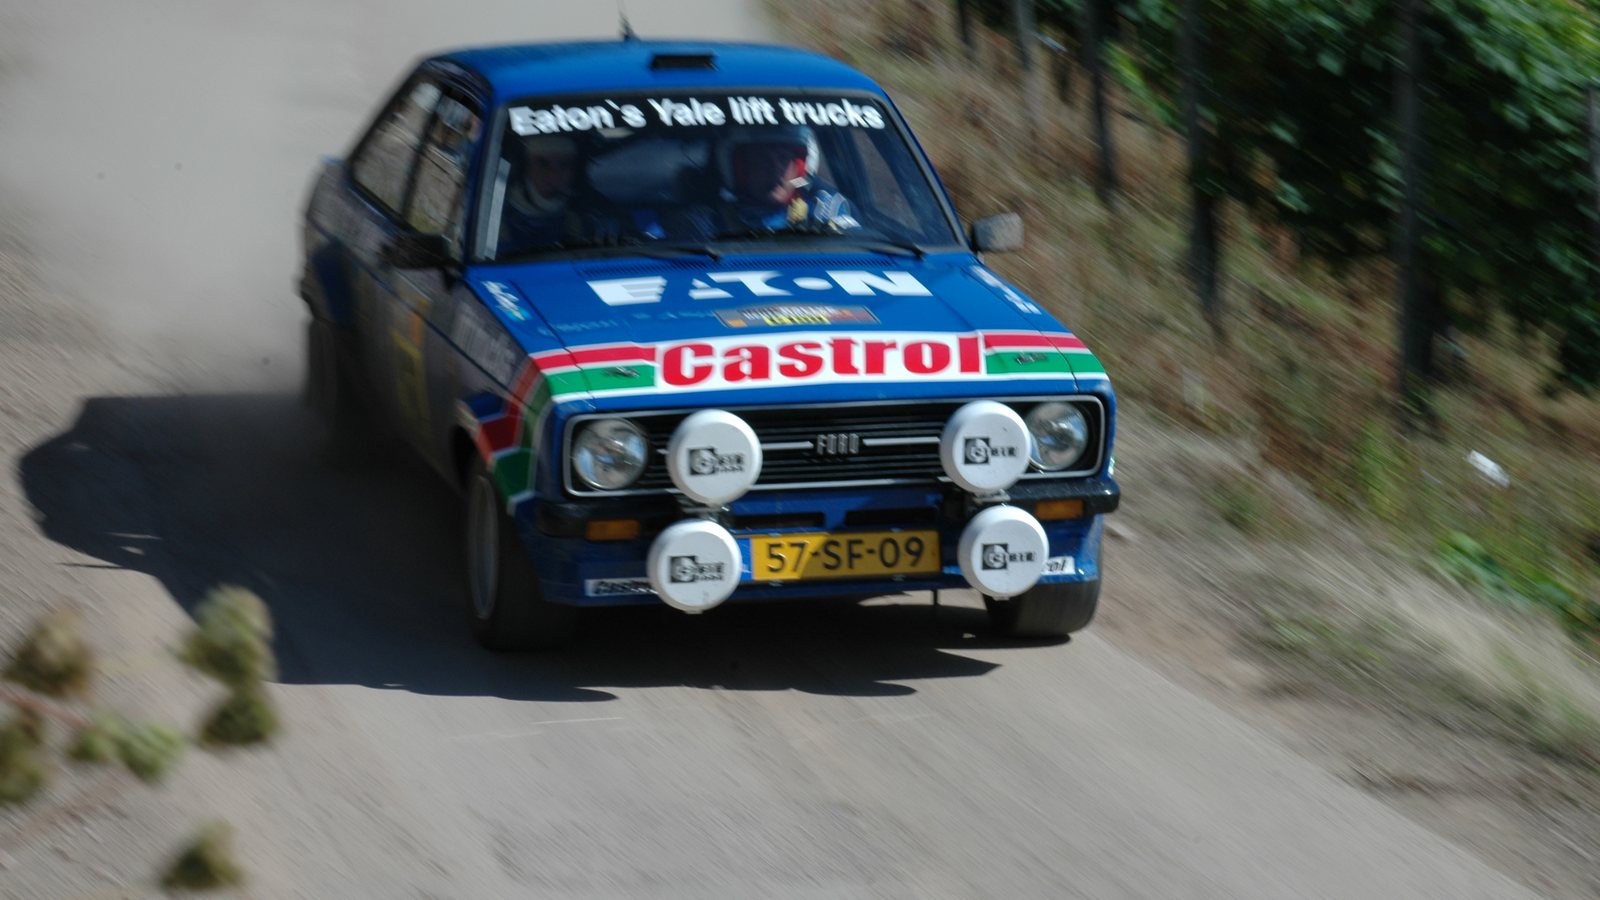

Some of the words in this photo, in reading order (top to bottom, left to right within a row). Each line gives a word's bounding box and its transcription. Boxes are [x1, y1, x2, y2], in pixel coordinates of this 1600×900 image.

[648, 97, 726, 126] Yale
[728, 96, 778, 124] lift
[778, 97, 886, 129] trucks
[662, 334, 983, 387] Castrol
[816, 433, 860, 455] FORD
[766, 536, 926, 574] 57-SF-09
